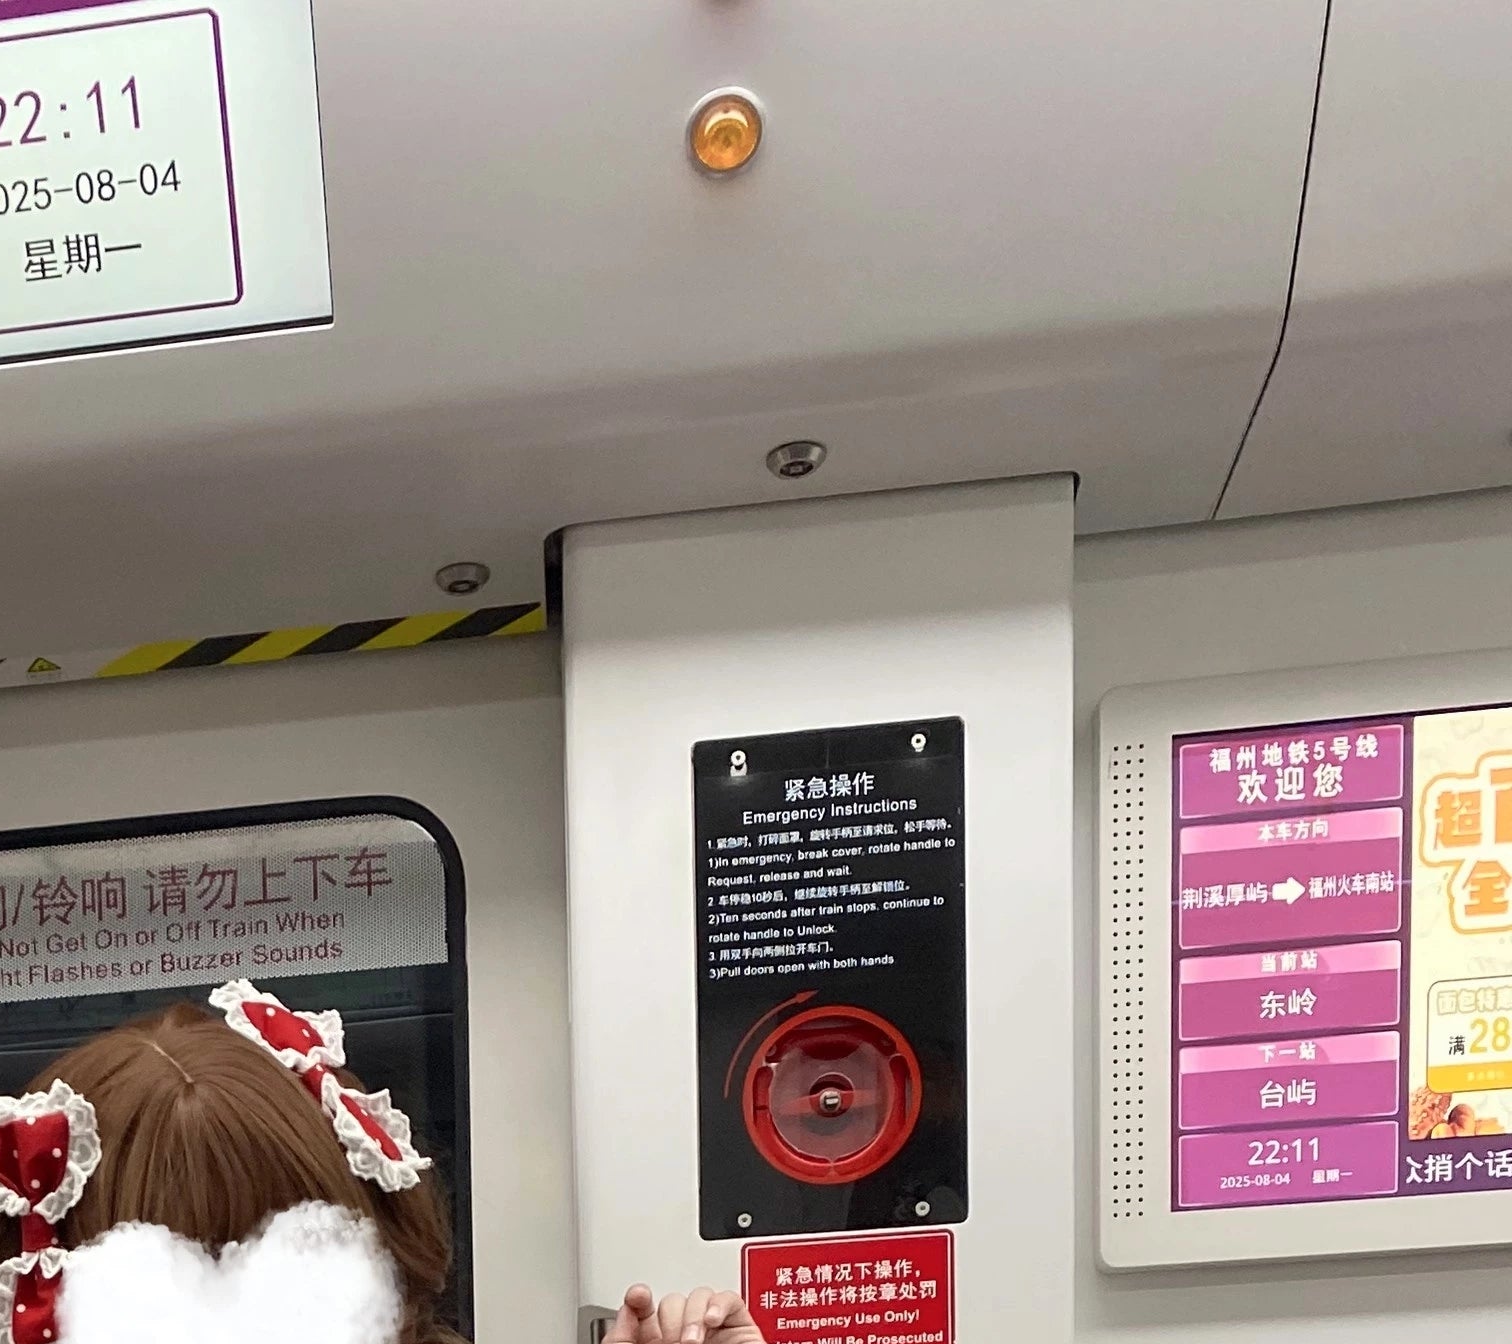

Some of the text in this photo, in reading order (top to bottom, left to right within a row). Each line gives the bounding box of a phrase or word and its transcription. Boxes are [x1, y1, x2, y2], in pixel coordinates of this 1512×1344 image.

[24, 233, 141, 282] 星期一
[1209, 733, 1378, 773] 福州地铁5号线
[784, 771, 874, 802] 紧急操作
[1238, 763, 1343, 805] 欢迎您
[742, 799, 917, 825] Emergency Instructions
[1258, 819, 1328, 841] 本车方向
[732, 853, 794, 866] emergency,
[798, 848, 828, 861] break
[831, 846, 864, 858] cover,
[868, 843, 900, 855] rotate
[903, 838, 942, 852] handle
[945, 838, 955, 848] to
[144, 847, 392, 919] 请勿上下车
[707, 865, 852, 887] Request, release and wait.
[1182, 871, 1394, 910] 荆溪厚屿 福州火车南站
[742, 909, 787, 921] seconds
[790, 905, 816, 917] after
[819, 903, 844, 915] train
[883, 897, 930, 910] continue
[933, 896, 944, 906] to
[46, 933, 88, 955] Get
[94, 930, 127, 951] On
[135, 926, 158, 945] or
[165, 922, 201, 944] Off
[207, 917, 268, 940] Train
[275, 910, 344, 932] When
[708, 932, 740, 944] rotate
[743, 928, 780, 940] handle
[783, 927, 794, 937] to
[29, 962, 122, 986] Flashes
[130, 957, 152, 976] or
[160, 951, 244, 974] Buzzer
[253, 940, 343, 964] Sounds
[743, 965, 775, 977] doors
[777, 963, 805, 975] open
[808, 959, 830, 971] with
[833, 957, 858, 969] both
[861, 955, 894, 967] hands
[1260, 951, 1317, 973] 当前站
[1260, 988, 1317, 1019] 东岭
[1260, 1041, 1316, 1063] 下一站
[1260, 1079, 1316, 1109] 台屿
[1248, 1137, 1319, 1166] 22:11
[1220, 1169, 1353, 1189] 2025-08-04 星期一
[776, 1259, 921, 1286] 紧急情况下操作，
[760, 1280, 937, 1310] 非法操作将按章处罚
[777, 1309, 919, 1330] Emergency Use Only!
